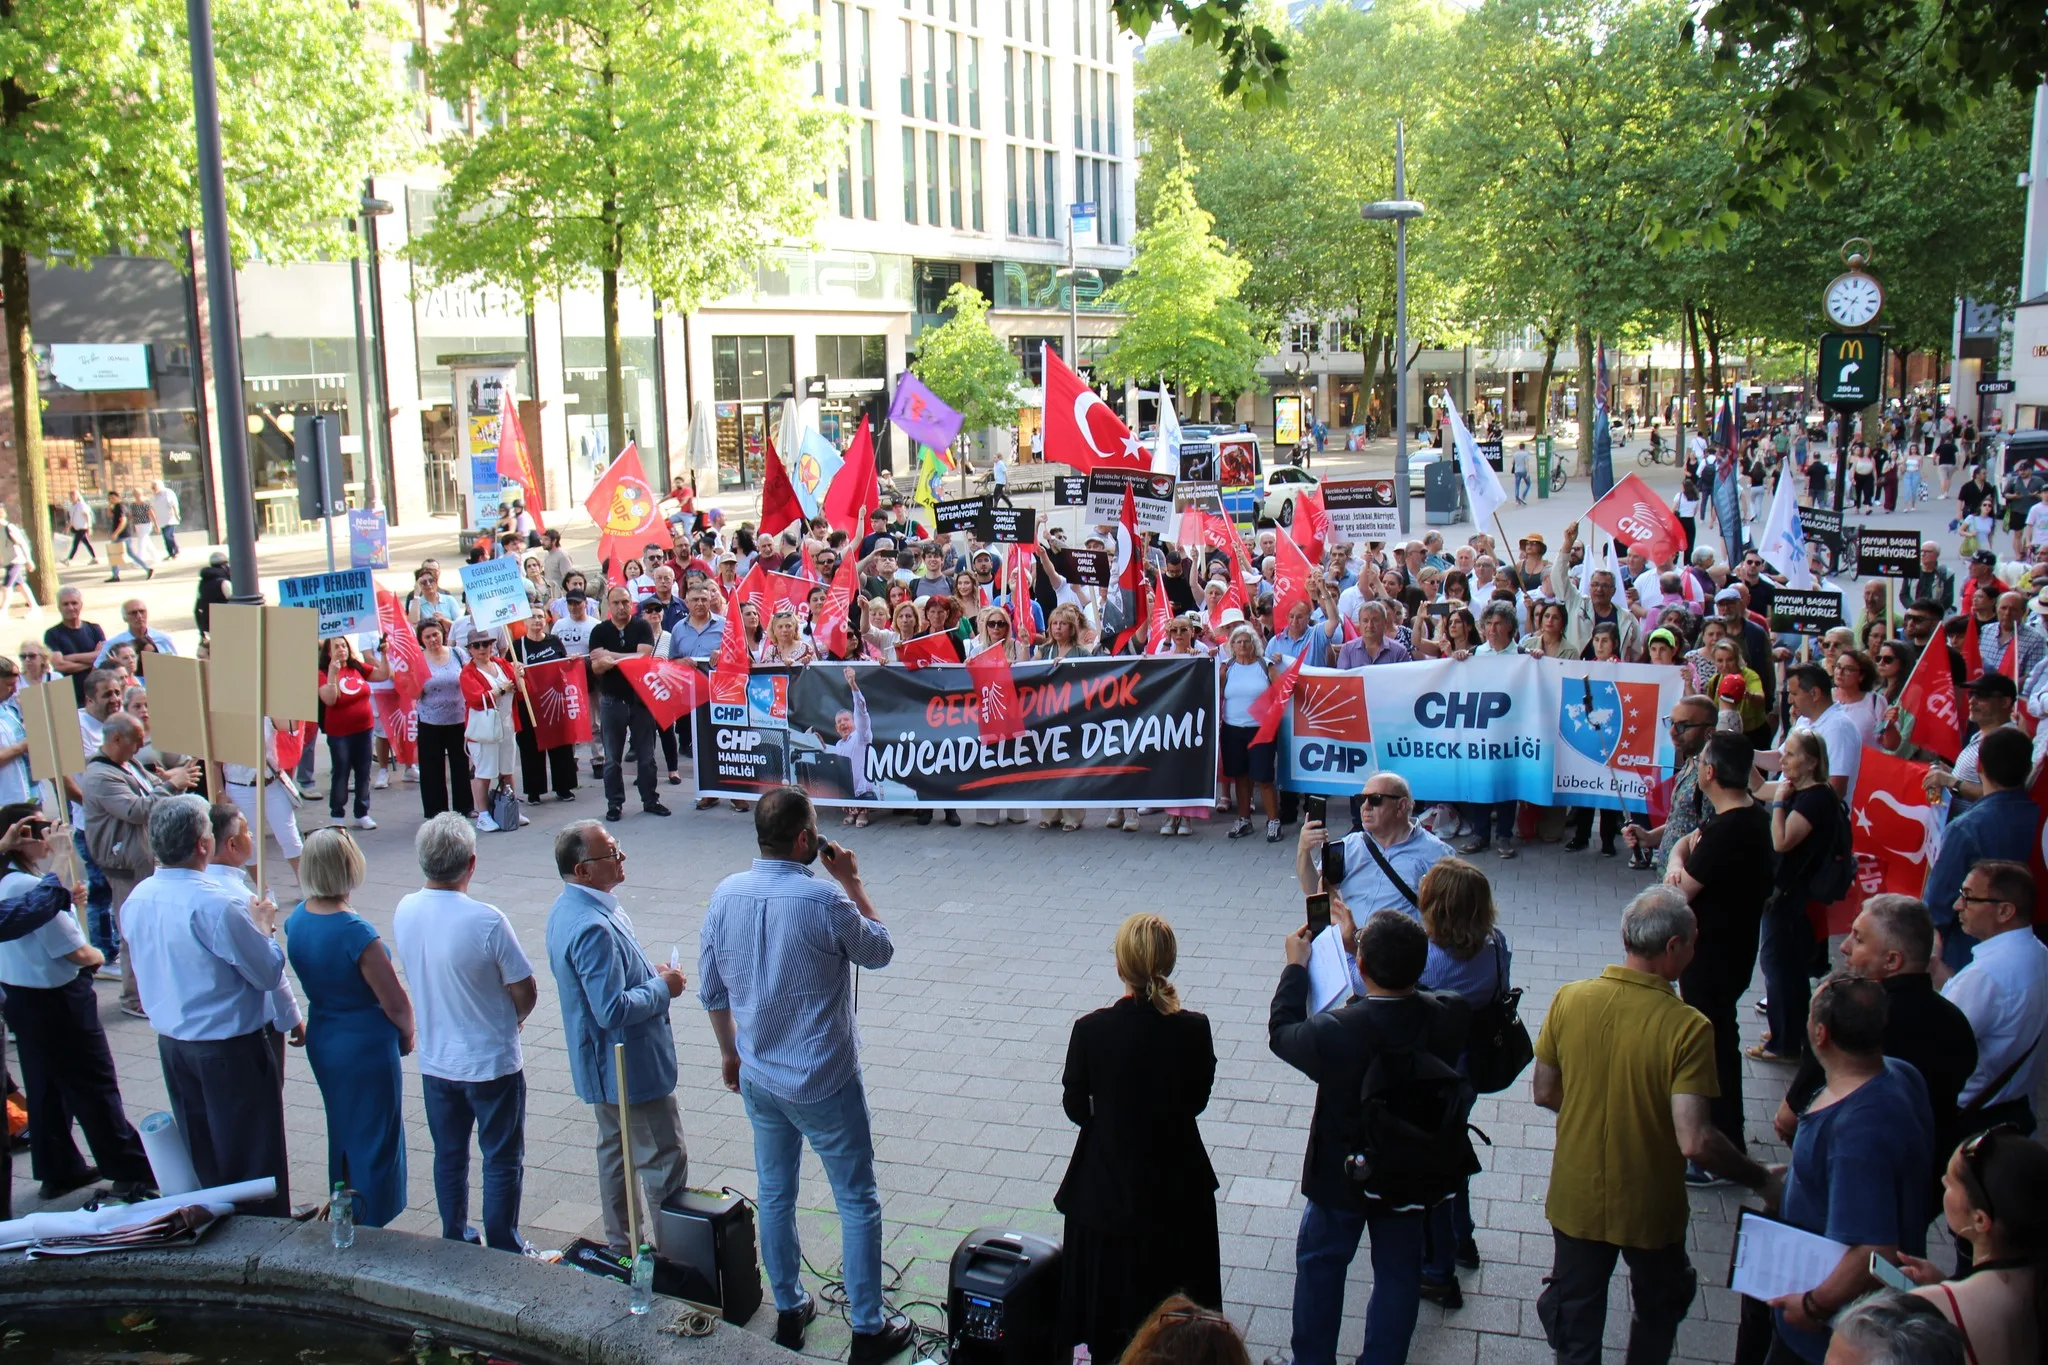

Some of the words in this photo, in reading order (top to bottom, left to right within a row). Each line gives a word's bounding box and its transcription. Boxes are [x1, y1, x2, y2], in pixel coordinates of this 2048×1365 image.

[1837, 385, 1851, 393] 200
[1979, 383, 2009, 392] CHRIST
[169, 451, 192, 463] Apollo
[937, 505, 959, 513] KAYYUM
[960, 501, 983, 510] BAŞKAN
[937, 509, 979, 521] İSTEMİYORU
[993, 523, 1016, 531] OMUZA
[1617, 517, 1653, 541] CHP
[1861, 536, 1887, 545] KAYYUM
[1889, 537, 1917, 547] BAŞKAN
[1861, 545, 1918, 558] İSTEMİYORUZ
[1077, 558, 1094, 566] OMUZ
[285, 580, 298, 598] YA
[301, 577, 320, 596] HEP
[324, 571, 368, 593] BERABER
[466, 577, 493, 591] KAYITSIZ
[494, 571, 518, 585] ŞARTSIZ
[1774, 595, 1804, 604] KAYYUM
[1807, 597, 1838, 607] BAŞKAN
[495, 607, 508, 618] CHP
[1774, 604, 1838, 618] İSTEMİYORUZ
[321, 620, 342, 631] CHP
[643, 671, 671, 701] CHP
[1081, 672, 1142, 714] YOK
[981, 686, 989, 724] CHP
[1414, 691, 1512, 730] CHP
[714, 706, 744, 721] CHP
[716, 728, 762, 751] CHP
[865, 725, 1072, 781] MÜCADELEYE
[1080, 708, 1206, 760] DEVAM!
[1388, 737, 1461, 760] LÜBECK
[1468, 735, 1540, 761] BİRLİĞİ
[718, 752, 767, 765] HAMBURG
[1299, 743, 1368, 774] CHP
[1617, 754, 1650, 766] CHP
[719, 765, 755, 778] BİRLİĞİ
[1556, 775, 1604, 790] Lübeck
[1610, 776, 1649, 798] Birliğ
